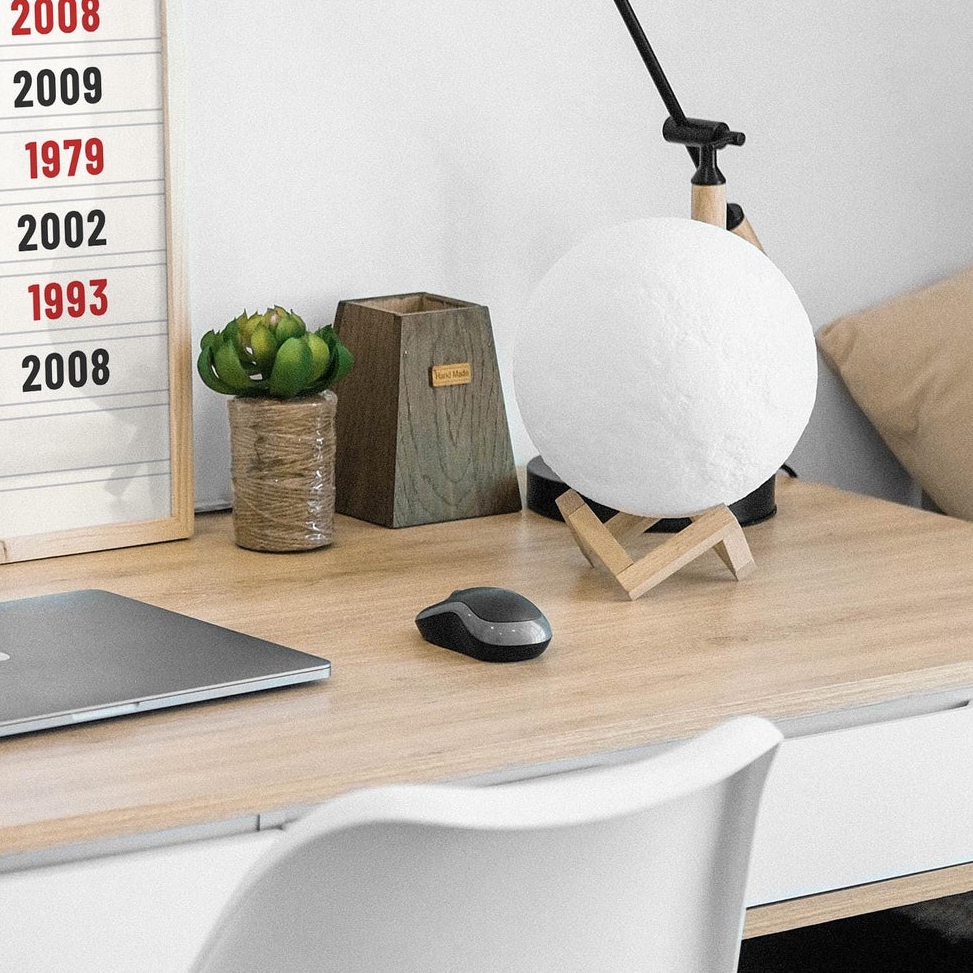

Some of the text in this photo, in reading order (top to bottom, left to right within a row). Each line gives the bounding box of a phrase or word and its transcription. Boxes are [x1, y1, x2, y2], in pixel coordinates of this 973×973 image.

[13, 66, 102, 108] 2009
[24, 137, 104, 179] 1979
[17, 209, 107, 252] 2002
[27, 278, 108, 321] 1993
[21, 348, 110, 393] 2008
